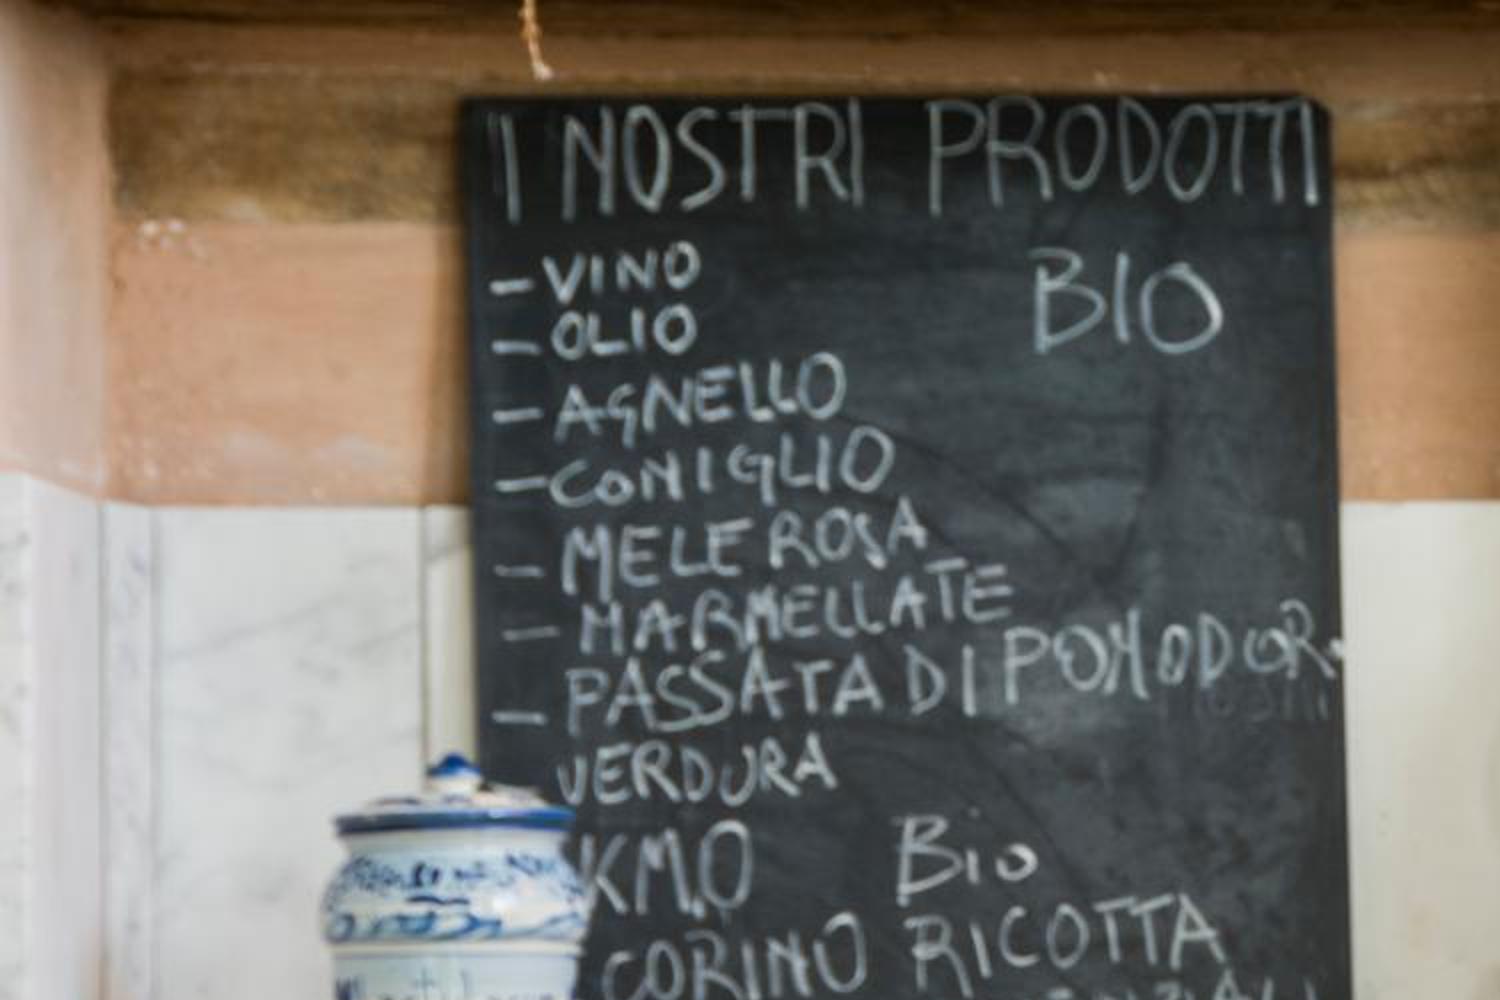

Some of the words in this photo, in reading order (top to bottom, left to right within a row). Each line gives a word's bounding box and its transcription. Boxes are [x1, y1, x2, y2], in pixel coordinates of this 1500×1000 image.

[500, 113, 521, 224] I
[562, 97, 864, 223] NOSTRI
[926, 96, 1318, 217] PRODOTTI
[542, 241, 699, 304] VINO
[1028, 247, 1223, 354] BIO
[551, 303, 697, 360] OLIO
[553, 351, 847, 449] AGNELLO
[549, 425, 895, 506] CONIGLIO
[562, 517, 753, 601] MELE
[580, 557, 1013, 654] MARMELLATE
[566, 646, 885, 736] PASSATA
[903, 644, 976, 716] DI
[557, 732, 838, 806] VERDURA
[904, 892, 1226, 997] RICOTTA
